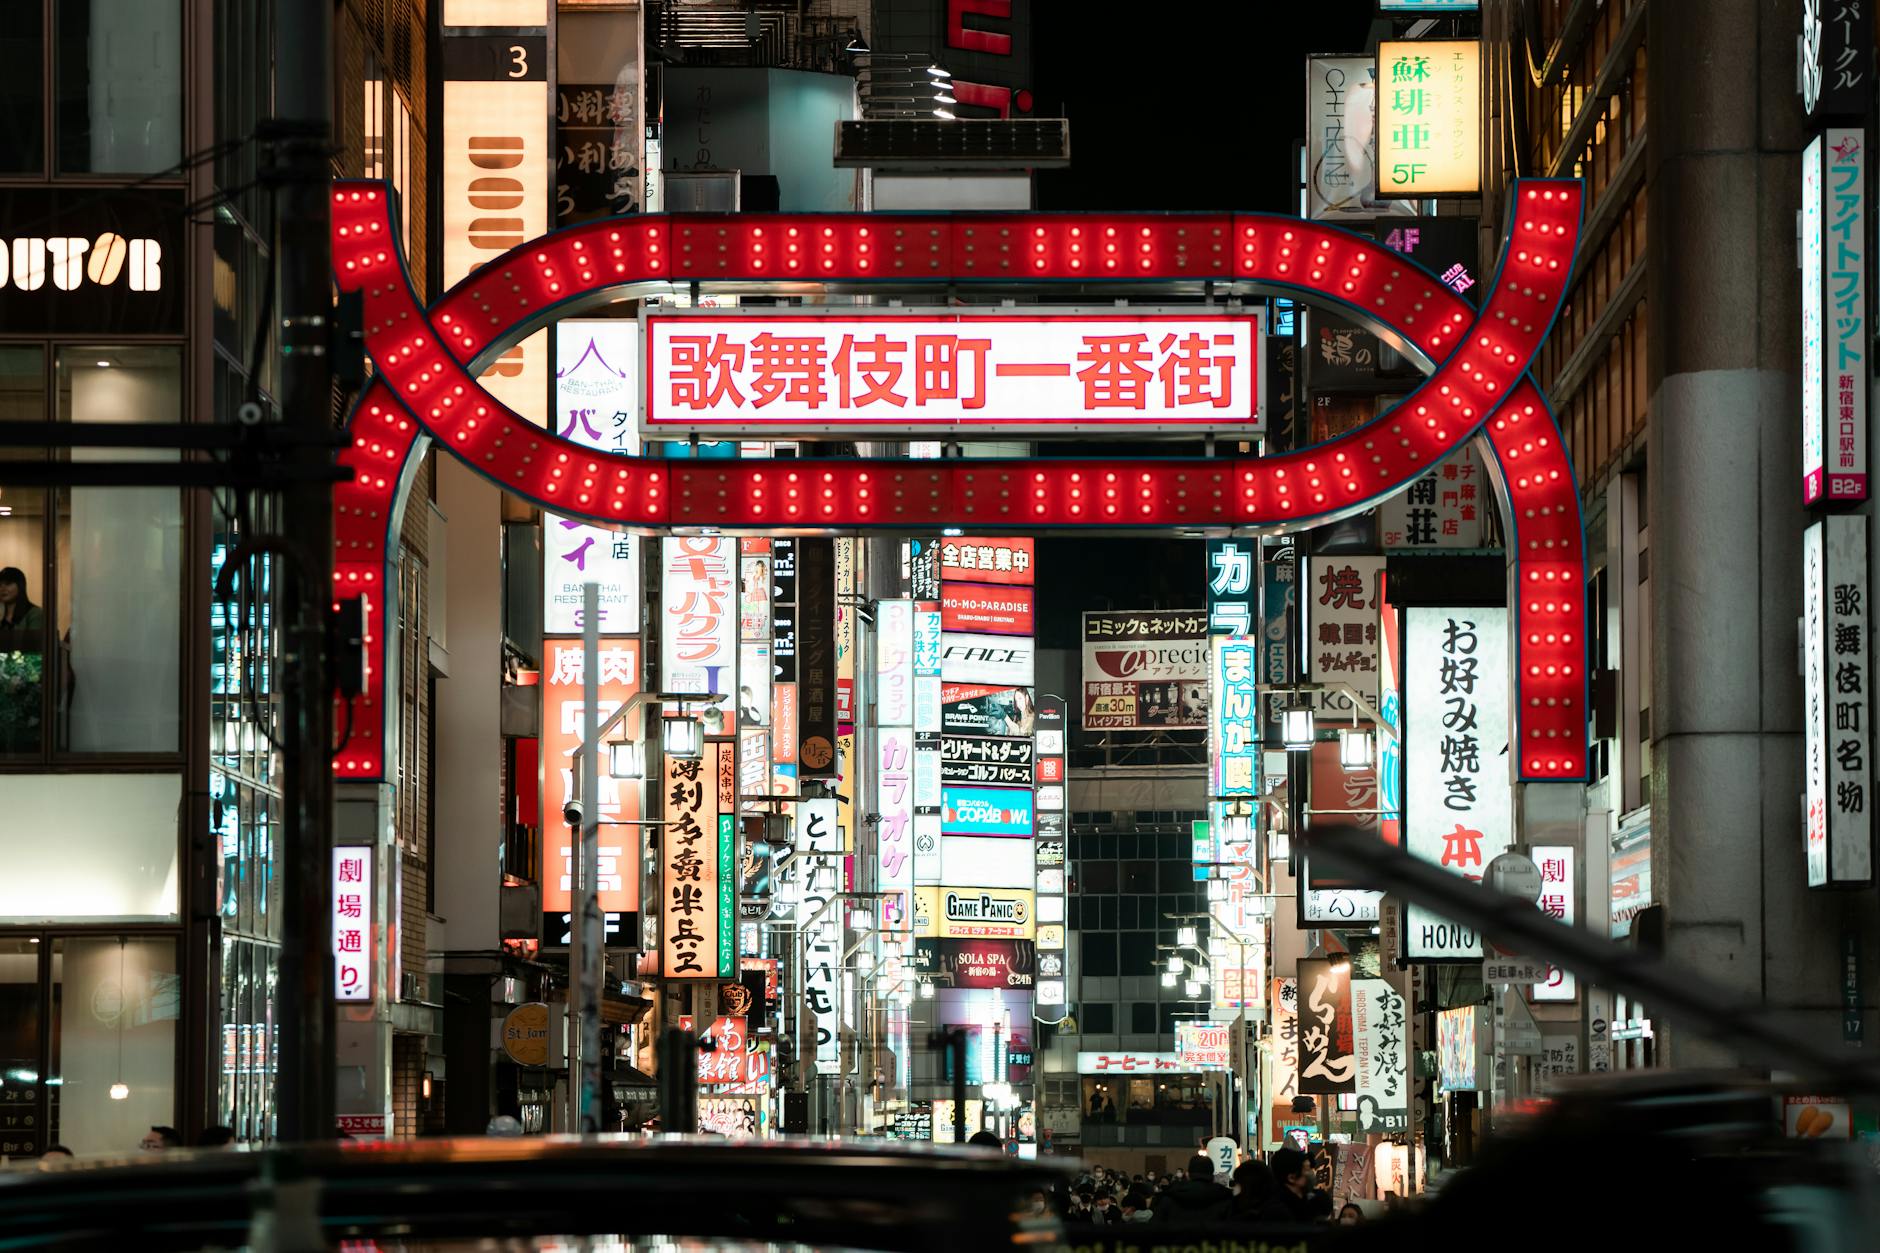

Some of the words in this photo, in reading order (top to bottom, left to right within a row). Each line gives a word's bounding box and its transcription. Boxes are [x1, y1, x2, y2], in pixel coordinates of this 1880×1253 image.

[508, 46, 528, 77] 3
[1392, 163, 1427, 184] 5F
[1385, 228, 1420, 253] 4F
[1441, 263, 1464, 282] CLUB
[669, 331, 1237, 410] 歌舞伎町一番街
[1317, 397, 1331, 407] 2F
[1839, 375, 1855, 467] 新宿東口駅前
[1832, 479, 1861, 494] B2F
[1442, 465, 1458, 535] 専門店
[1385, 532, 1401, 545] 3F
[942, 543, 1029, 573] 全店営業中
[943, 598, 1029, 612] MO-MO-PARADISE
[927, 613, 940, 667] カラオケ
[550, 647, 635, 685] 焼肉
[943, 646, 1030, 664] FACE
[1088, 682, 1136, 695] 新宿最大
[1833, 583, 1864, 814] 歌舞伎町名物
[945, 713, 968, 721] BRAVE
[968, 714, 990, 722] POINT
[1440, 618, 1479, 811] お好み焼き
[941, 740, 1031, 763] ビリヤード&ダーツ
[720, 750, 733, 804] 炭火串焼
[999, 767, 1031, 781] バグース
[882, 737, 909, 877] カラオケ
[947, 894, 978, 917] GAME
[981, 896, 1013, 918] PANIC
[338, 858, 362, 988] 劇場通り
[958, 952, 984, 964] SOLA
[986, 953, 1006, 965] SPA
[1356, 990, 1368, 1033] HIROSHIMA
[1846, 1020, 1861, 1033] 17
[1359, 1036, 1369, 1063] TEPPAN
[1095, 1055, 1150, 1070] コーヒー
[1360, 1065, 1370, 1089] YAKI
